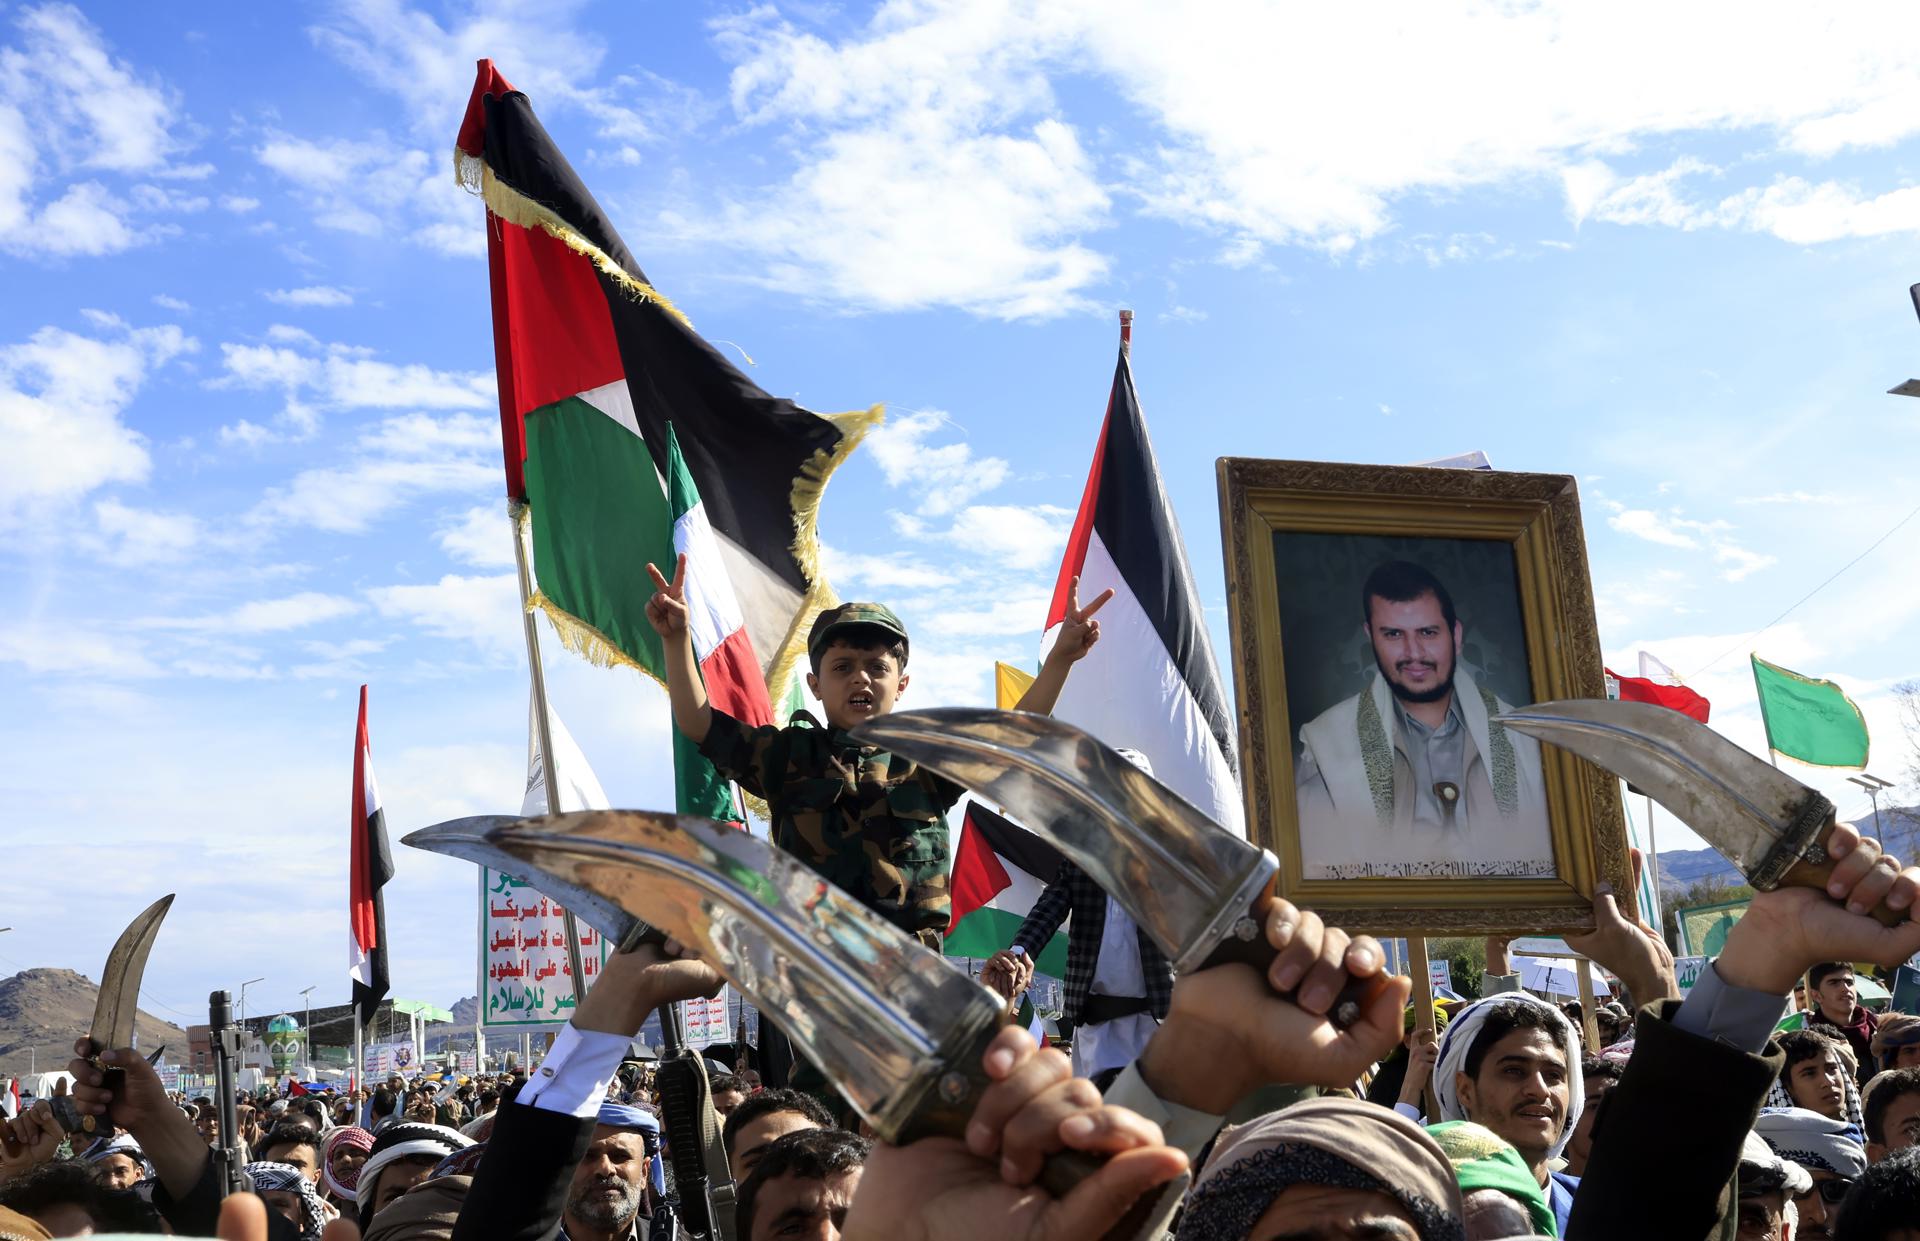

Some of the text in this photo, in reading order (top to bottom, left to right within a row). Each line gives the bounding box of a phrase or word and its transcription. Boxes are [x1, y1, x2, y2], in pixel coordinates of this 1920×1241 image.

[489, 957, 530, 982] اليهود
[535, 959, 557, 982] على
[490, 986, 545, 1018] للإسلام
